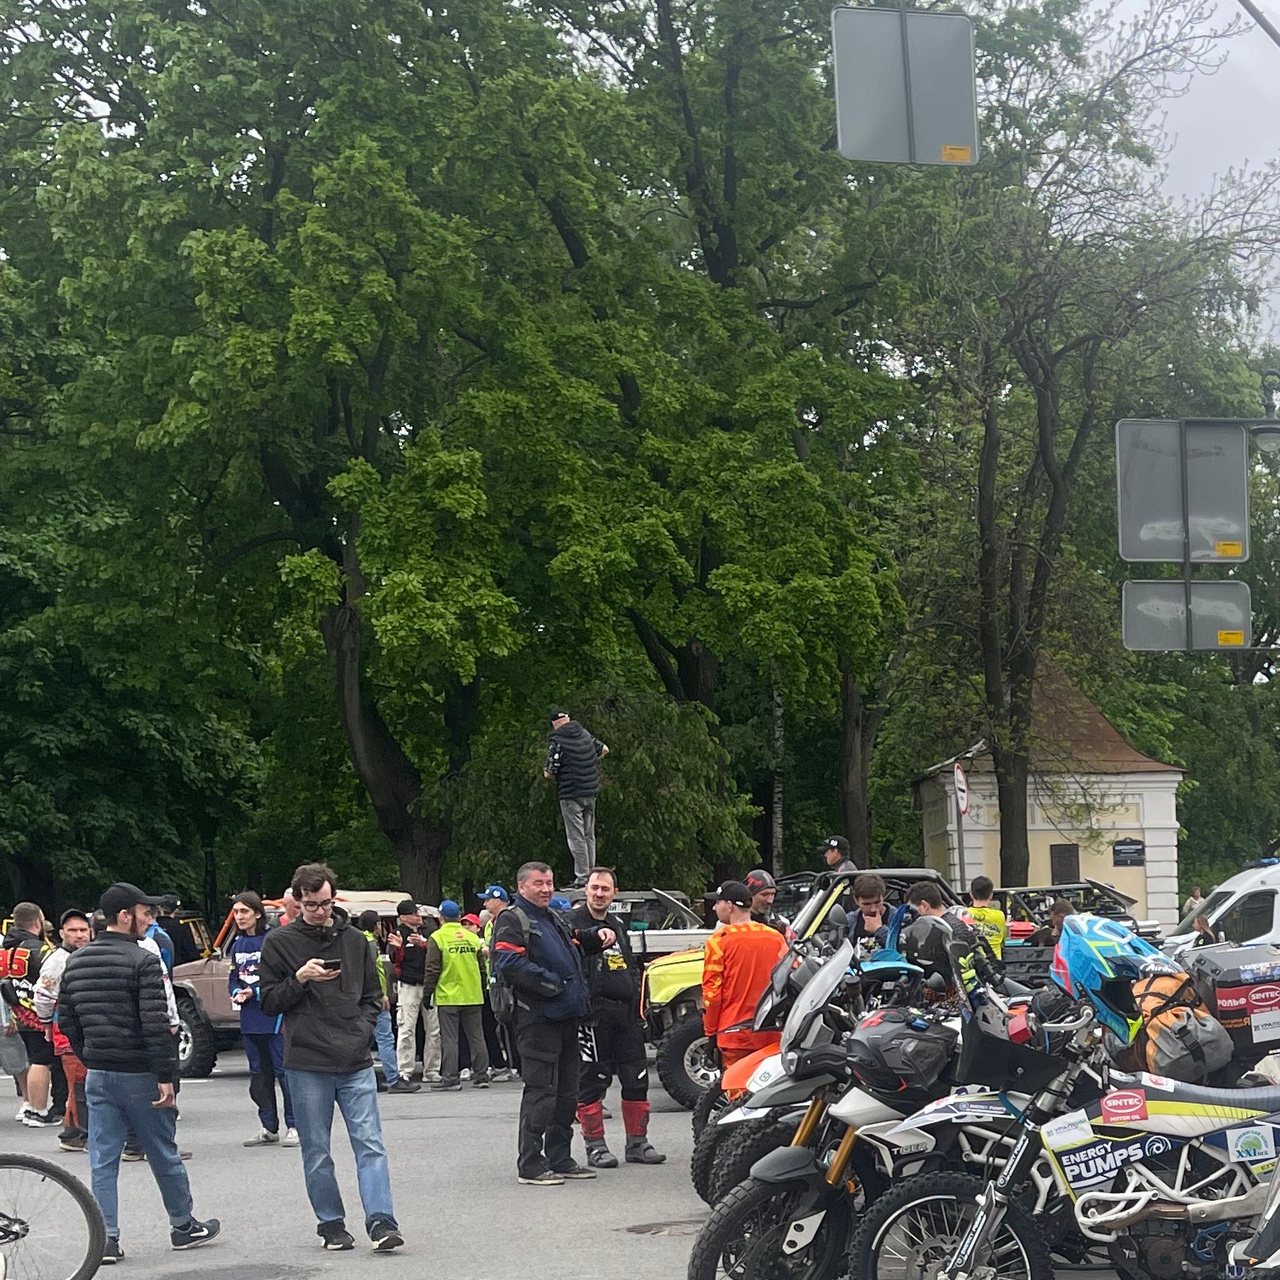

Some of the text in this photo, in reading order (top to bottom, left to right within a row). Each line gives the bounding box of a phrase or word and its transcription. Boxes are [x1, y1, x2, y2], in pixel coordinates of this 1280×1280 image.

[1250, 990, 1280, 1000] SINTEC
[1106, 1097, 1141, 1107] SINTEC
[1061, 1142, 1113, 1166] ENERGY
[1064, 1143, 1144, 1181] PUMPS
